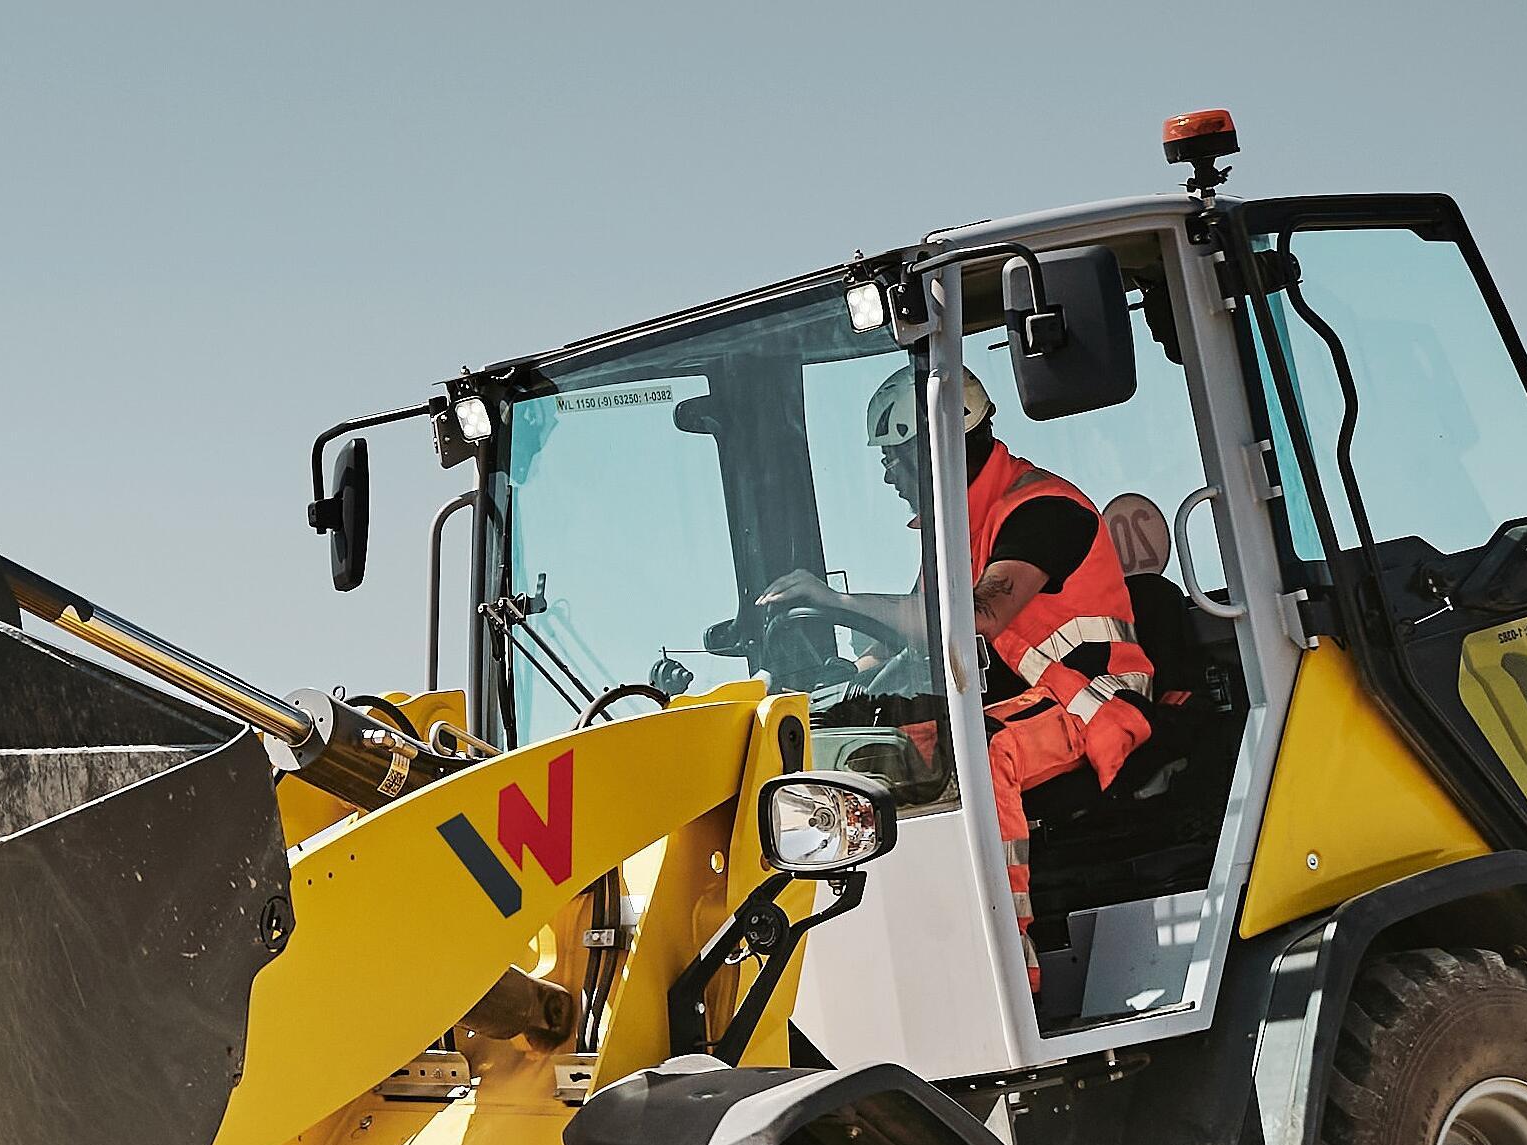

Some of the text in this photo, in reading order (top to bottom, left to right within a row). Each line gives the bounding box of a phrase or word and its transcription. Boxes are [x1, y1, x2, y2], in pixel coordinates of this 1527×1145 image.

[558, 390, 672, 411] WL 1150 (-9) 63250: 1-0382
